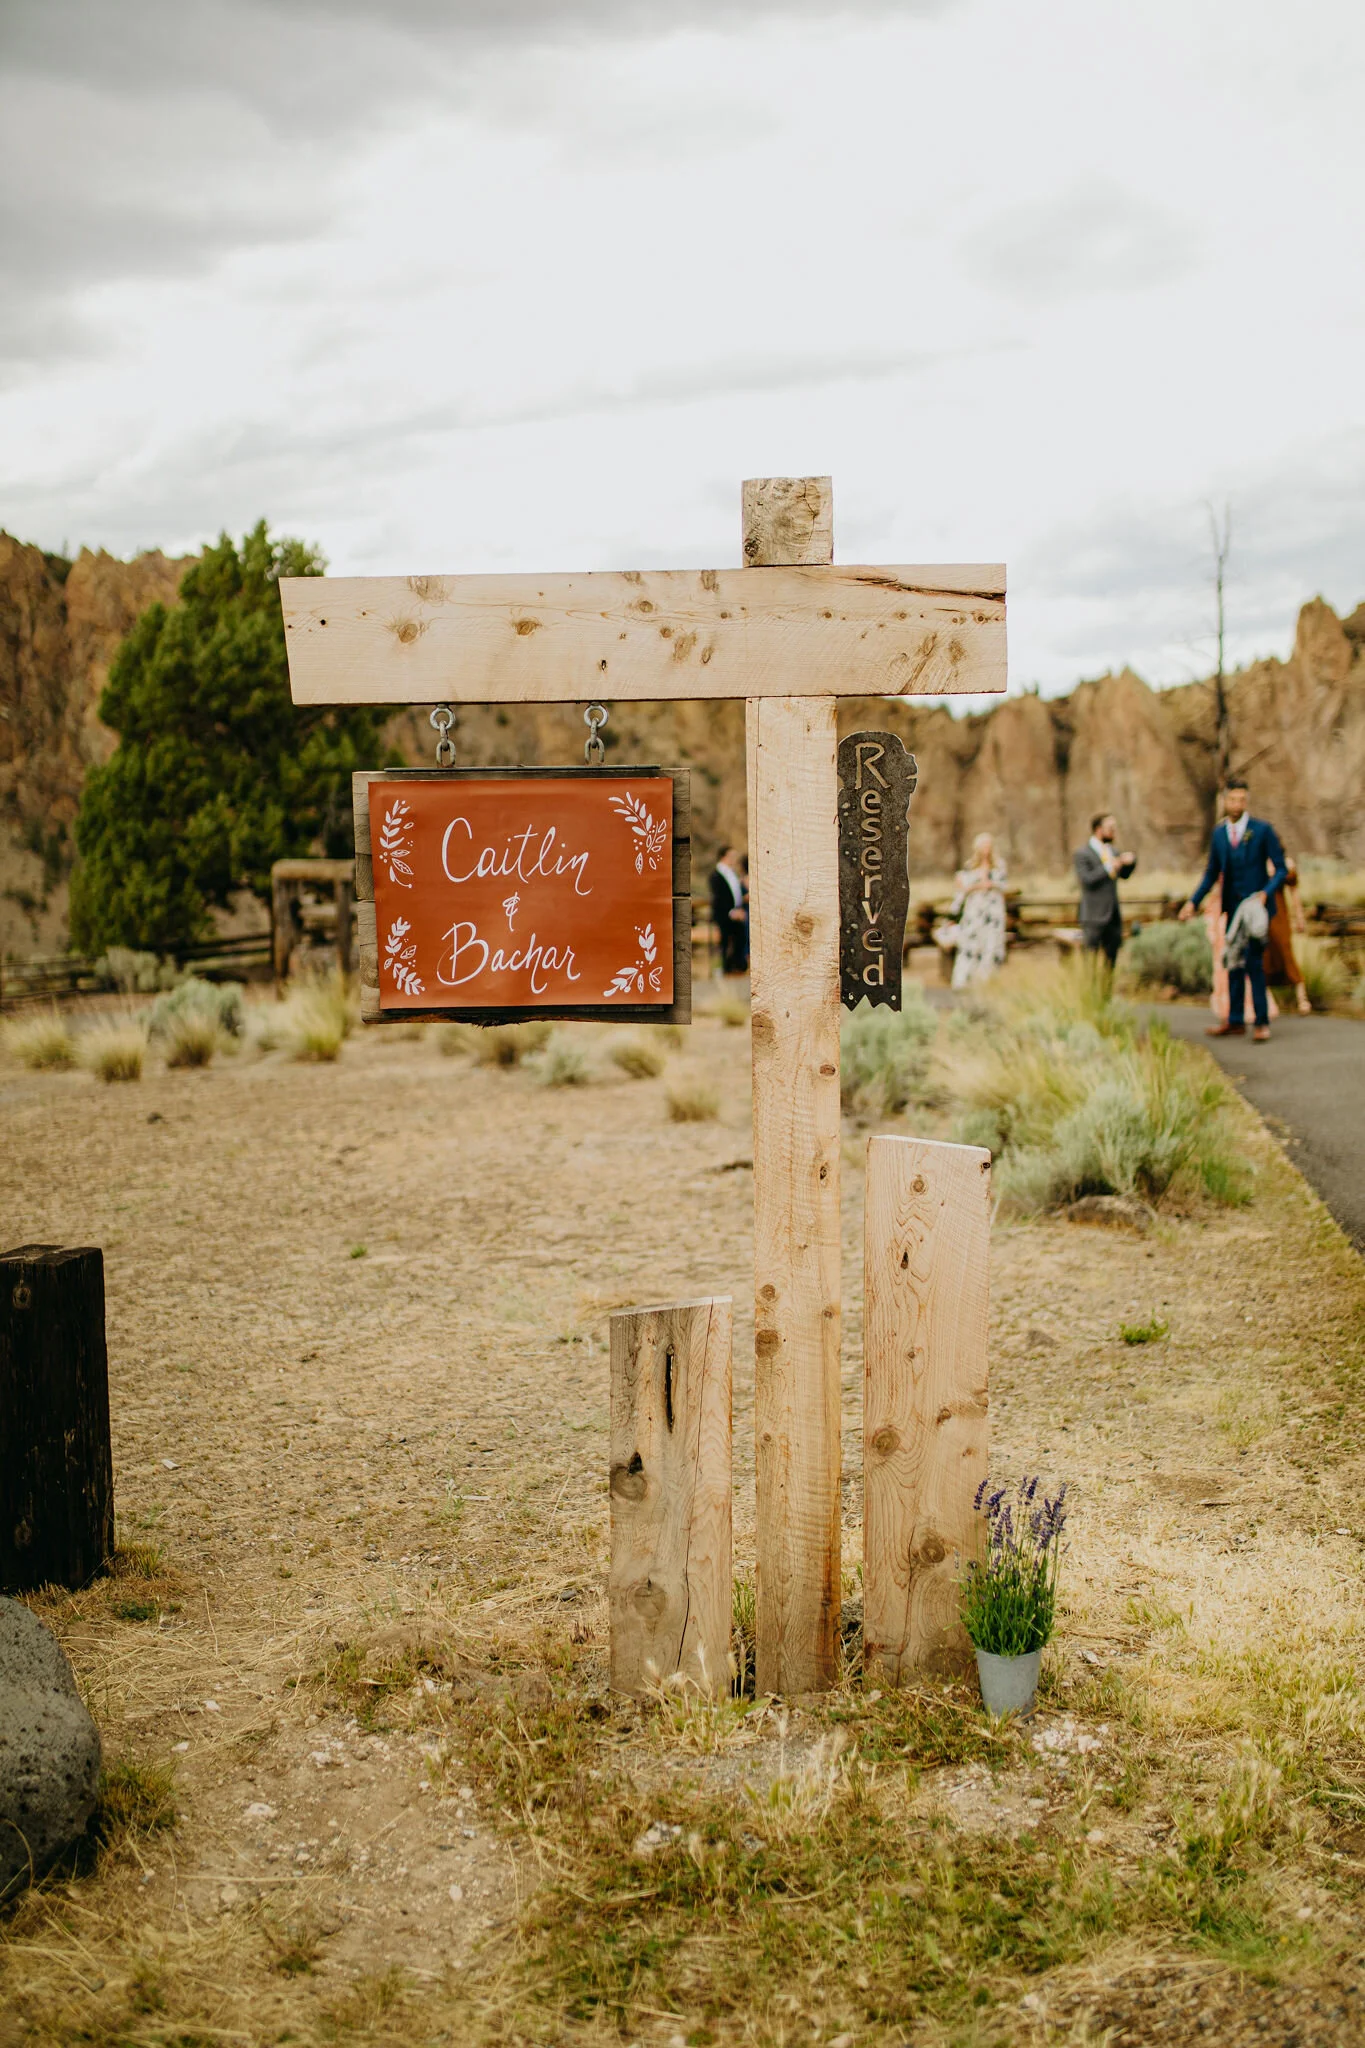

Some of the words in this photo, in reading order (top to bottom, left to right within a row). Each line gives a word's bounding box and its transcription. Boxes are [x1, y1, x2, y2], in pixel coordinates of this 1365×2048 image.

[441, 817, 594, 896] Caitlin
[854, 741, 891, 986] Reserved
[502, 891, 521, 932] &
[436, 921, 581, 994] Bachar
